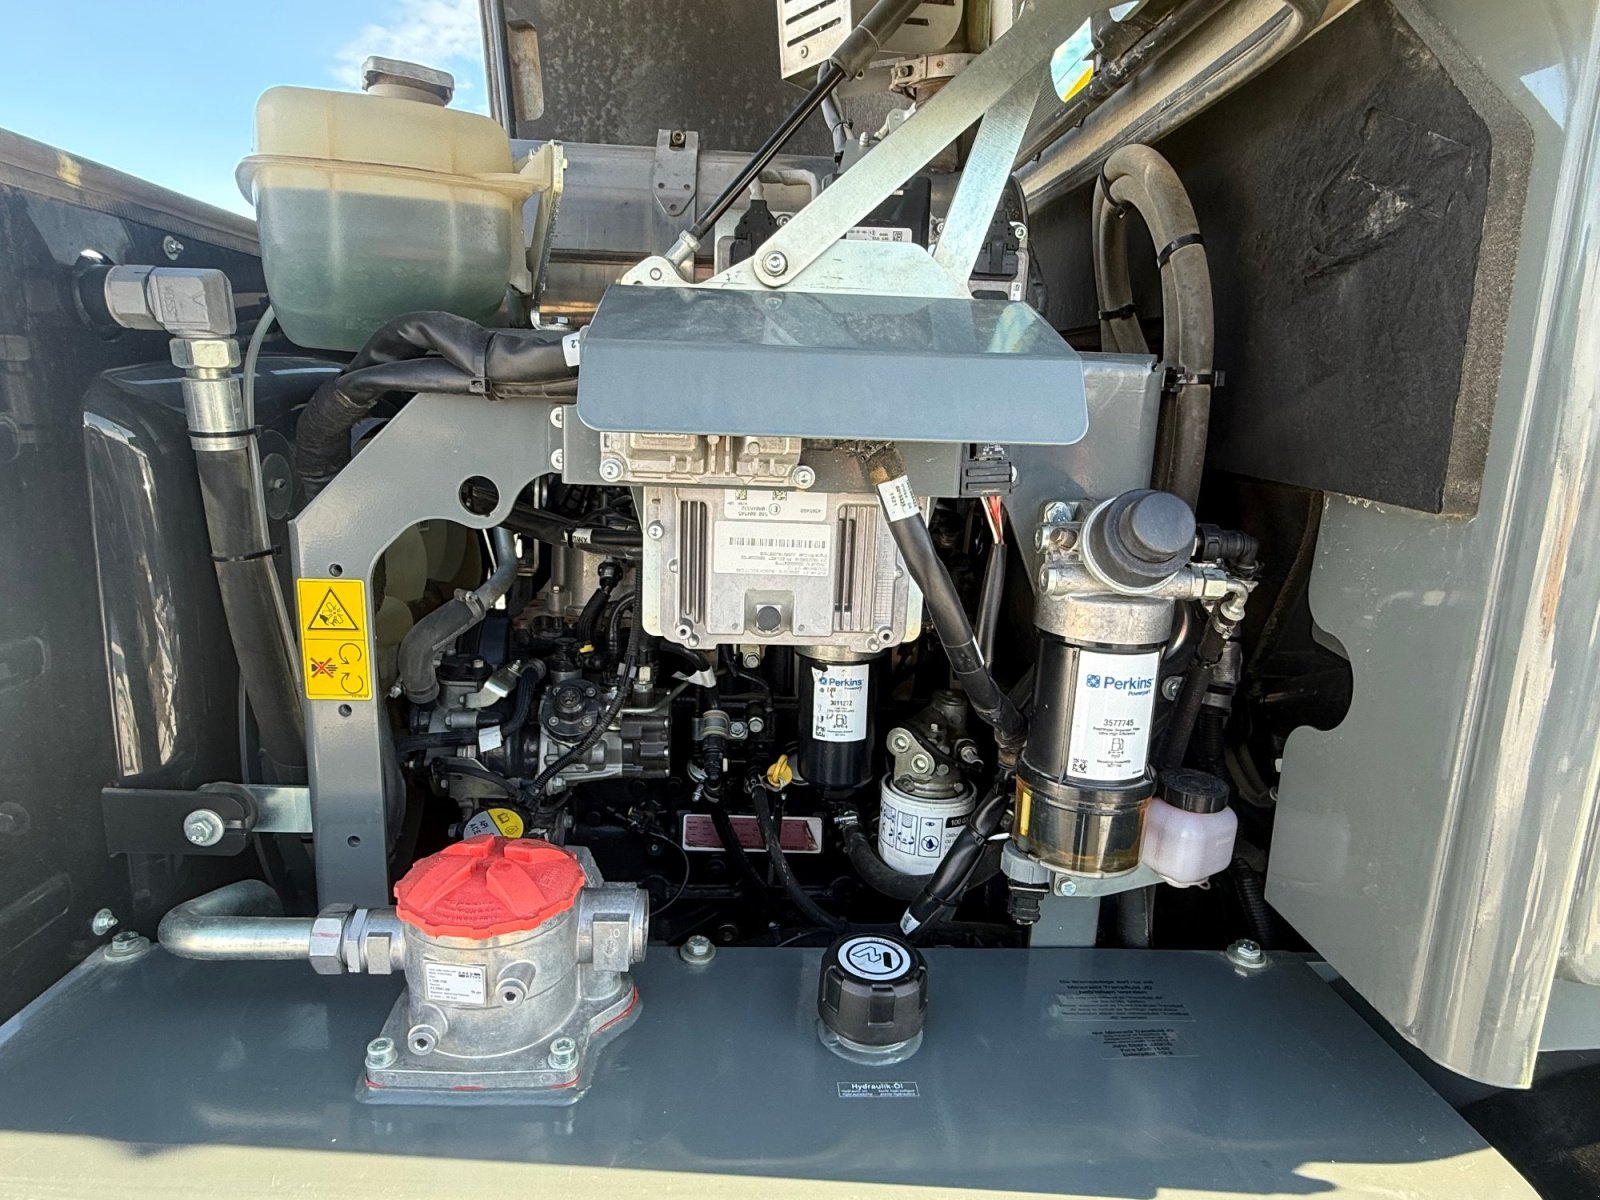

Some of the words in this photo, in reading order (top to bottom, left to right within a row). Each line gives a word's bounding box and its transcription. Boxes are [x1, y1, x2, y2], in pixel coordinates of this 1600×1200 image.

[828, 677, 863, 687] Perkins
[1103, 676, 1153, 690] Perkins
[1103, 719, 1135, 727] 3577745
[609, 928, 620, 938] 10
[851, 1082, 904, 1091] Hydraulik-Öl
